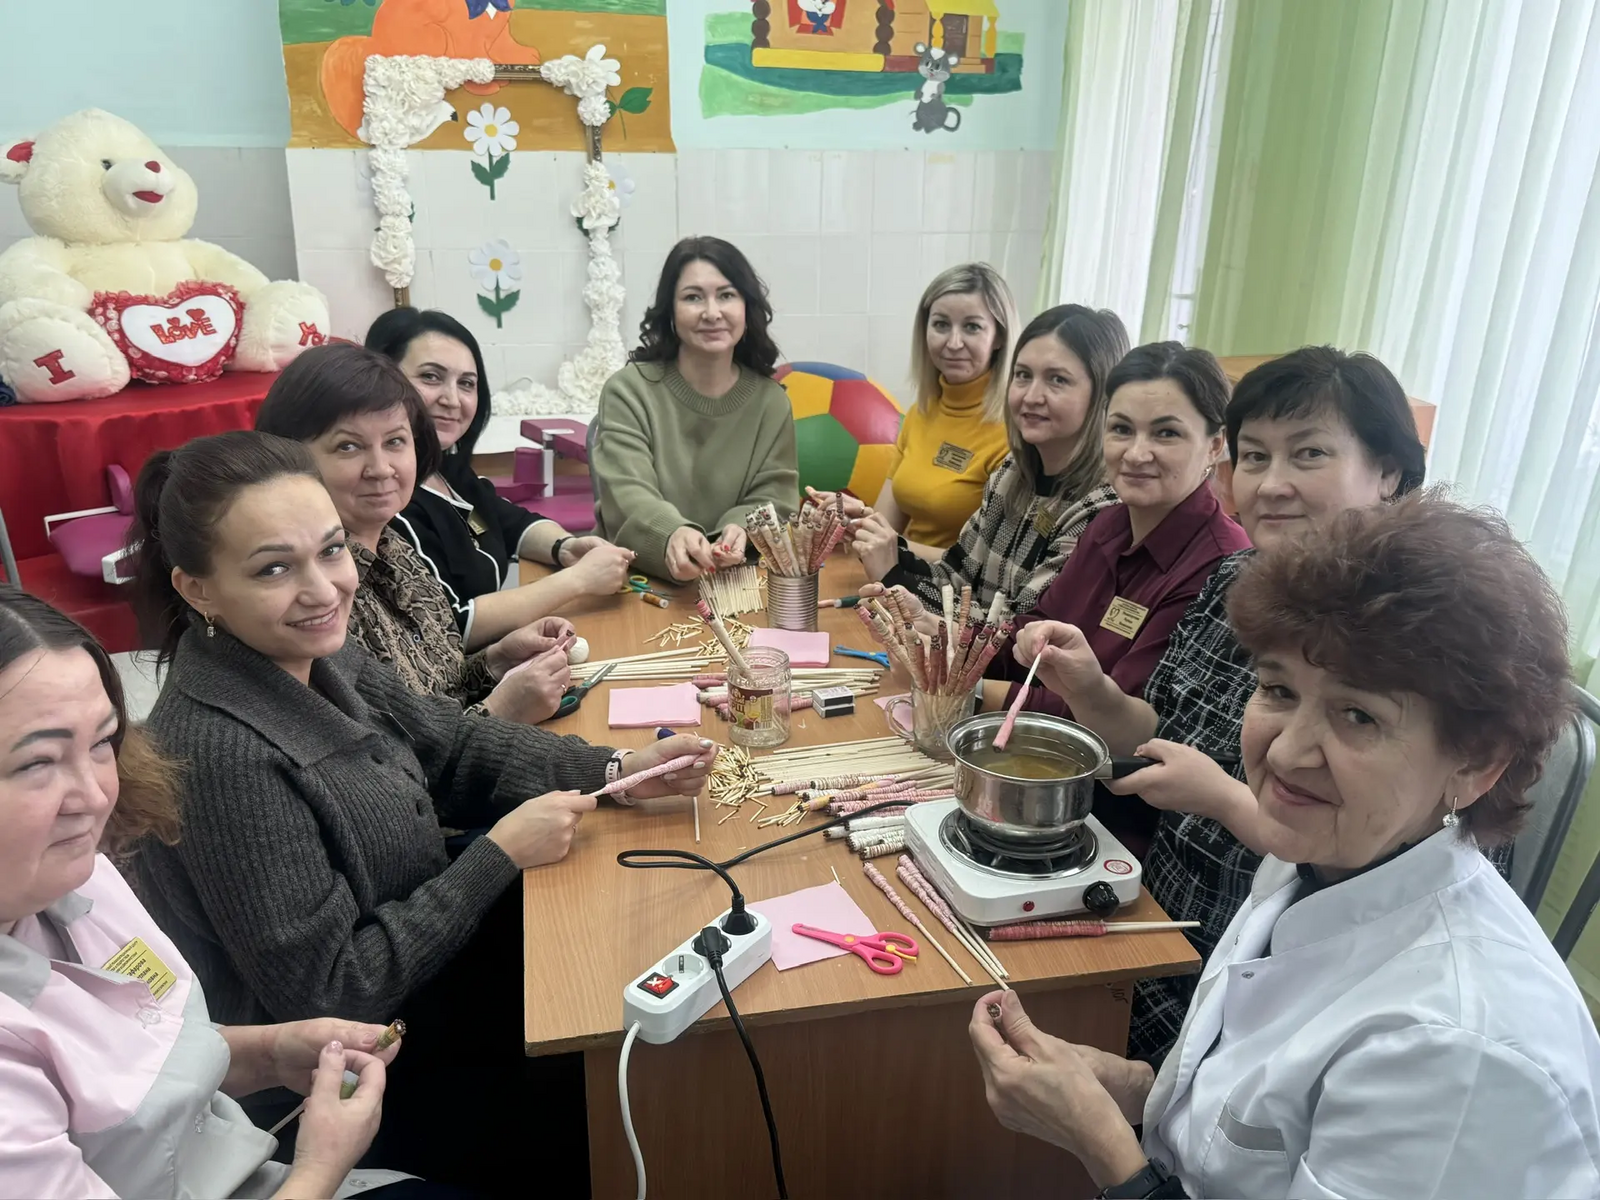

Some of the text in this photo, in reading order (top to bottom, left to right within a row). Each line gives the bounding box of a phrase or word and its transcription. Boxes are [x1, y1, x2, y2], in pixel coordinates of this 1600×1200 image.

[150, 315, 218, 345] LOVE
[298, 321, 326, 346] Yo
[33, 349, 76, 385] I
[126, 958, 147, 977] афарова
